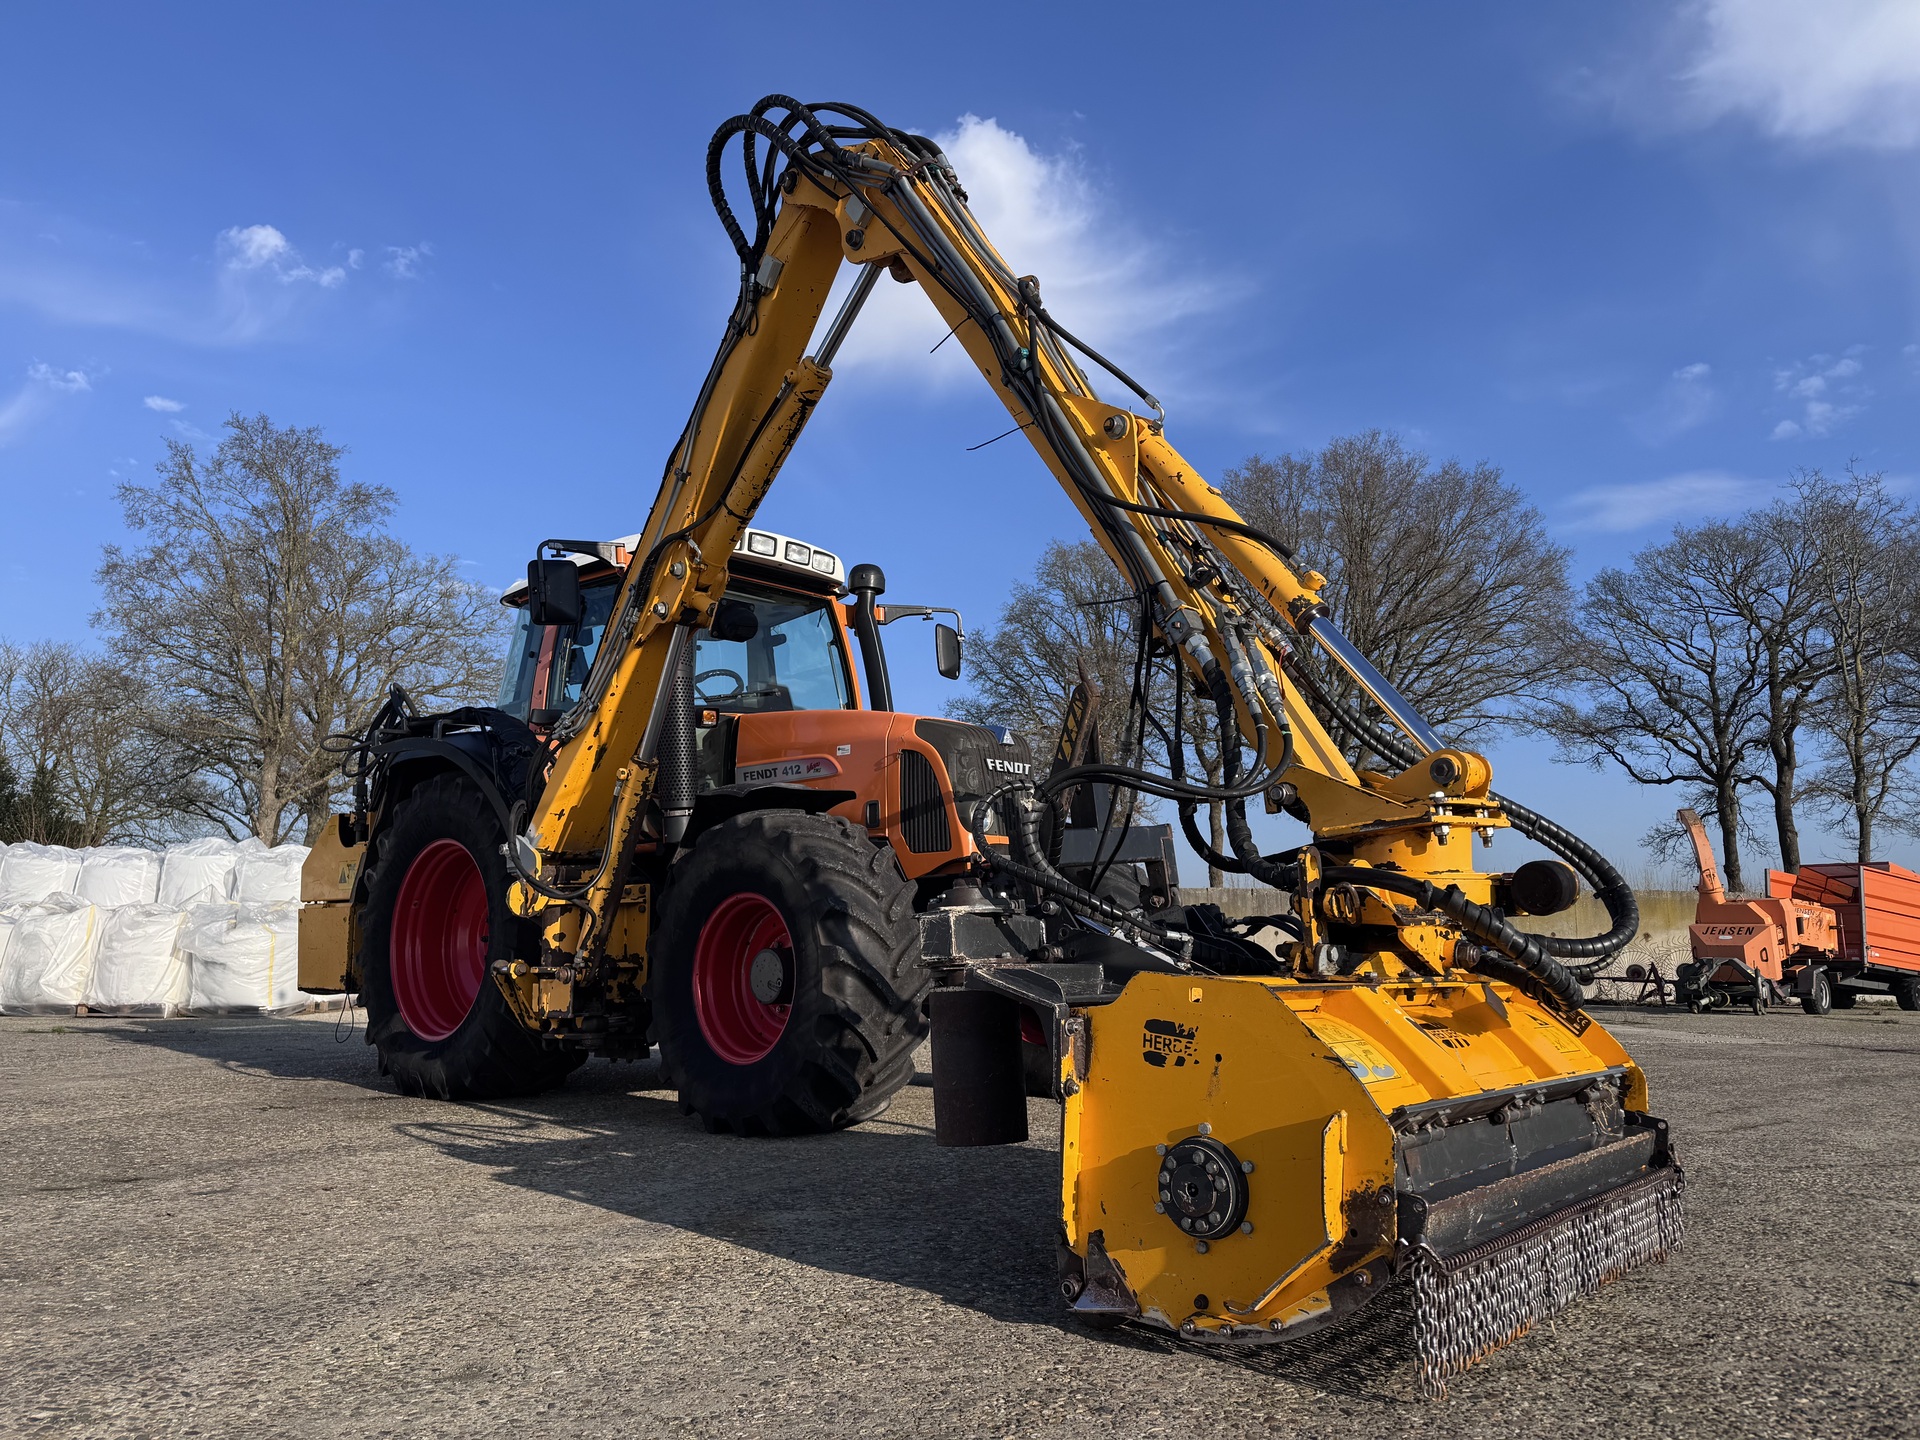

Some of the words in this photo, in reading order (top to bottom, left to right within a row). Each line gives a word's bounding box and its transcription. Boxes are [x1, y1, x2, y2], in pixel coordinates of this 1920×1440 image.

[743, 767, 778, 781] FENDT
[782, 764, 801, 776] 412
[986, 758, 1031, 775] FENDT
[1702, 926, 1755, 935] JENSEN
